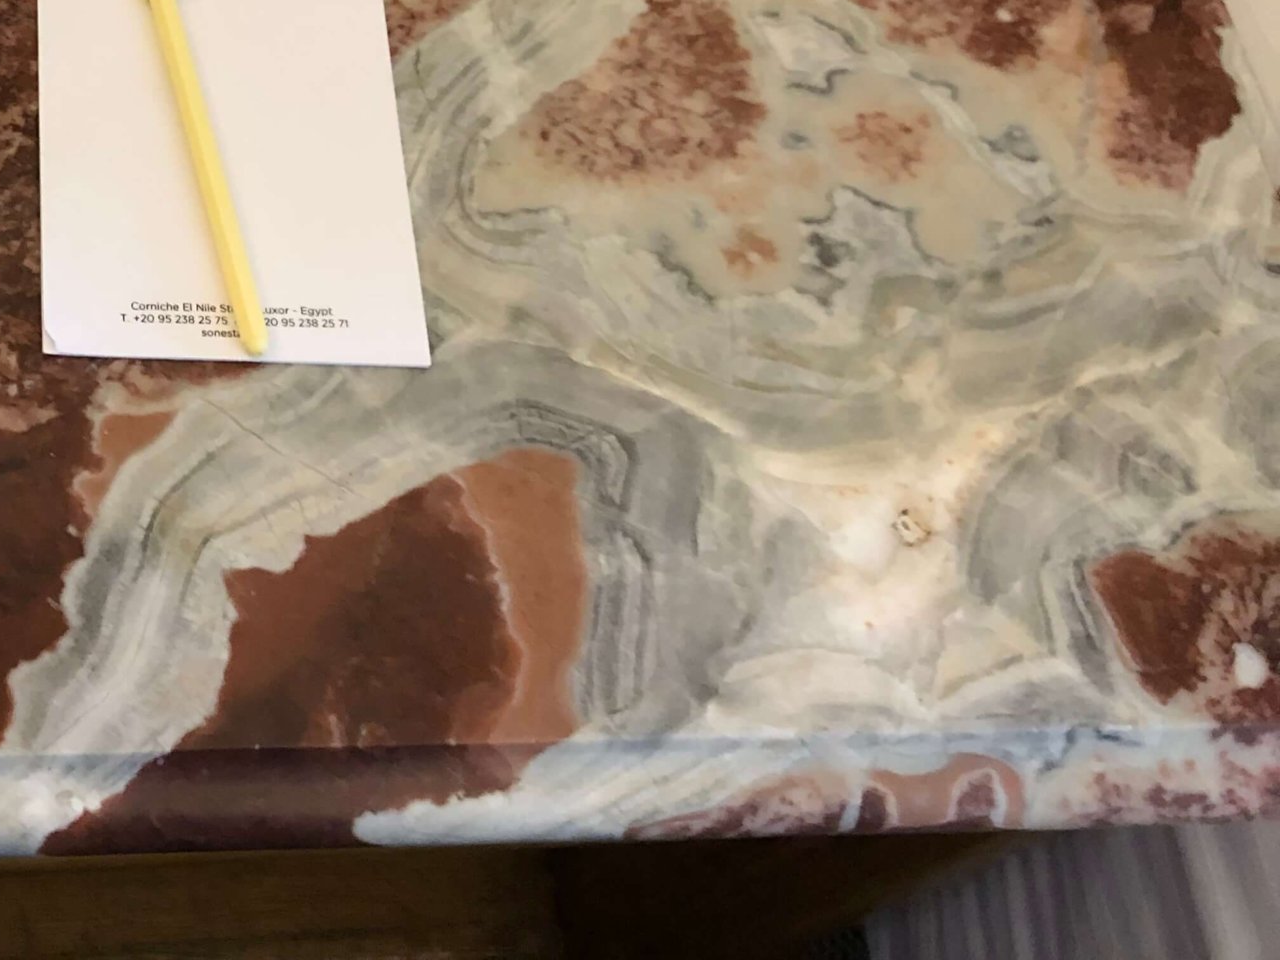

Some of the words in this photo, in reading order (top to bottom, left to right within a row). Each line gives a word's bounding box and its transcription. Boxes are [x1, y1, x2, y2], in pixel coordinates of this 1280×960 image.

[130, 301, 179, 311] Corniche
[182, 303, 192, 312] El
[196, 304, 216, 312] Nile
[300, 306, 333, 316] Egypt
[134, 314, 154, 323] +20
[158, 315, 172, 323] 95
[175, 315, 195, 324] 238
[198, 316, 212, 325] 25
[215, 316, 228, 325] 75
[281, 318, 295, 327] 95
[299, 318, 319, 328] 238
[322, 319, 335, 328] 25
[339, 319, 349, 328] 71
